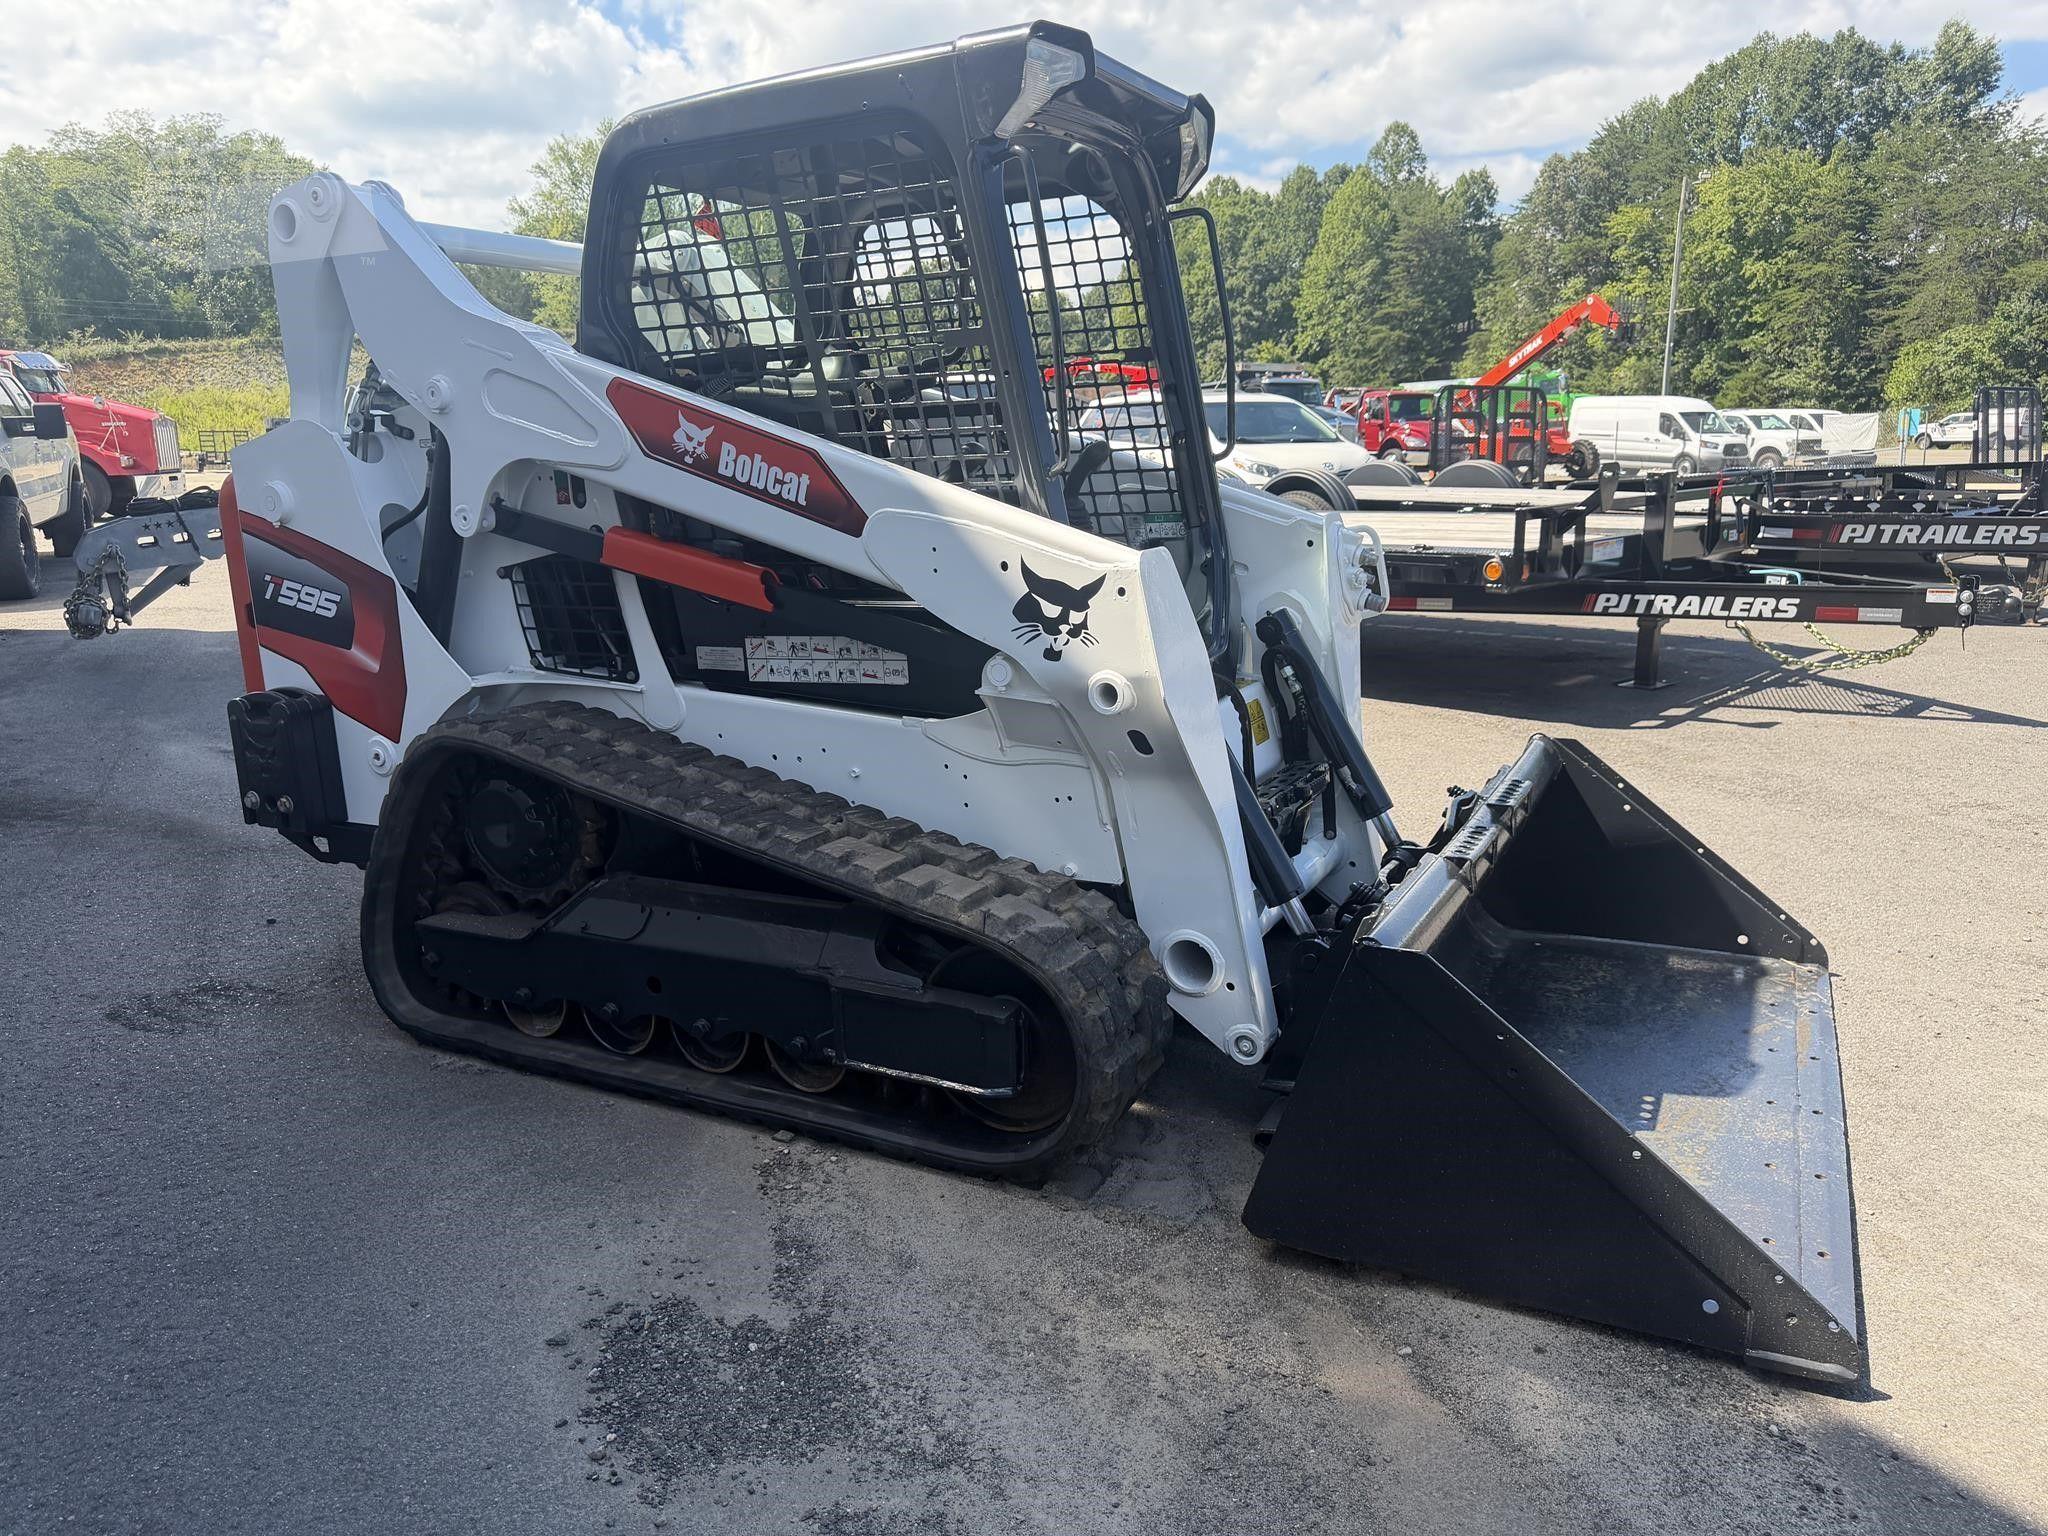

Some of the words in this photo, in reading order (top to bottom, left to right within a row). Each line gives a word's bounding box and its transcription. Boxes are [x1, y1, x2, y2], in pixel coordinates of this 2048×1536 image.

[718, 441, 810, 506] Bobcat
[1839, 524, 1877, 544] PJ
[1879, 524, 2041, 545] TRAILERS
[264, 574, 342, 618] T595
[1593, 593, 1632, 613] PJ
[1634, 594, 1800, 618] TRAILERS
